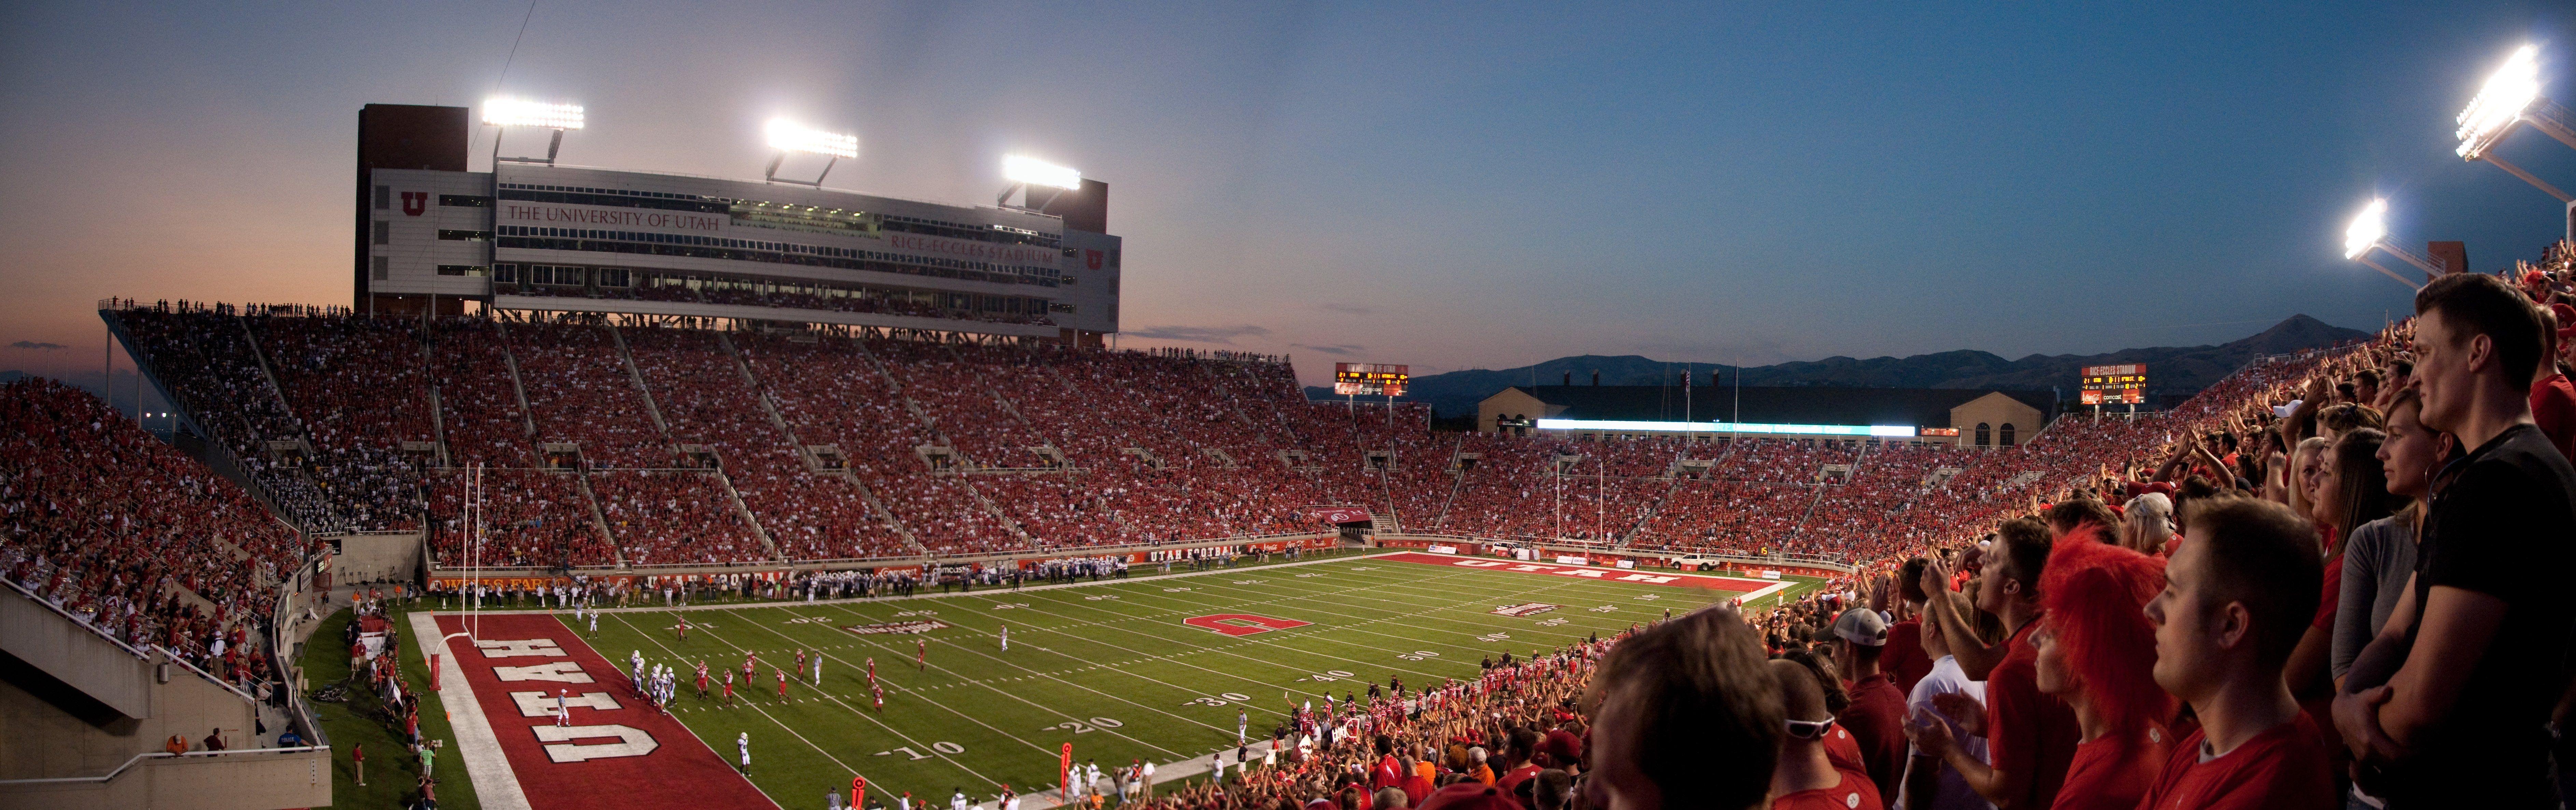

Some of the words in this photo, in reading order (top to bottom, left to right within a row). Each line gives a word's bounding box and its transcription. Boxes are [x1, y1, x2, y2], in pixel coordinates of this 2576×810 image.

[401, 192, 427, 216] U
[508, 206, 540, 220] THE
[547, 208, 643, 226] UNIVERSITY
[649, 213, 670, 227] OF
[676, 215, 718, 230] UTAH
[892, 236, 984, 257] RICE-ECCLES
[990, 246, 1053, 263] STADIUM
[1086, 249, 1103, 270] U
[1347, 363, 1375, 372] UNIVERSITY
[2090, 365, 2115, 376] RICE-ECCLES
[2117, 365, 2136, 375] STADIUM
[1733, 423, 1773, 433] University
[1824, 425, 1852, 434] Center
[1151, 549, 1182, 562] UTAH
[1187, 545, 1242, 559] FOOTBALL
[1452, 560, 1682, 583] UTAH
[510, 579, 566, 591] FARGO
[1520, 606, 1560, 616] WEST
[1181, 613, 1316, 637] U
[1535, 618, 1570, 626] 30
[1476, 633, 1511, 642] 40
[1396, 651, 1440, 661] 50
[1312, 670, 1355, 682] 40
[477, 638, 661, 764] UTAH
[1194, 693, 1251, 707] 30
[1058, 717, 1124, 735] 20
[893, 741, 965, 761] 10
